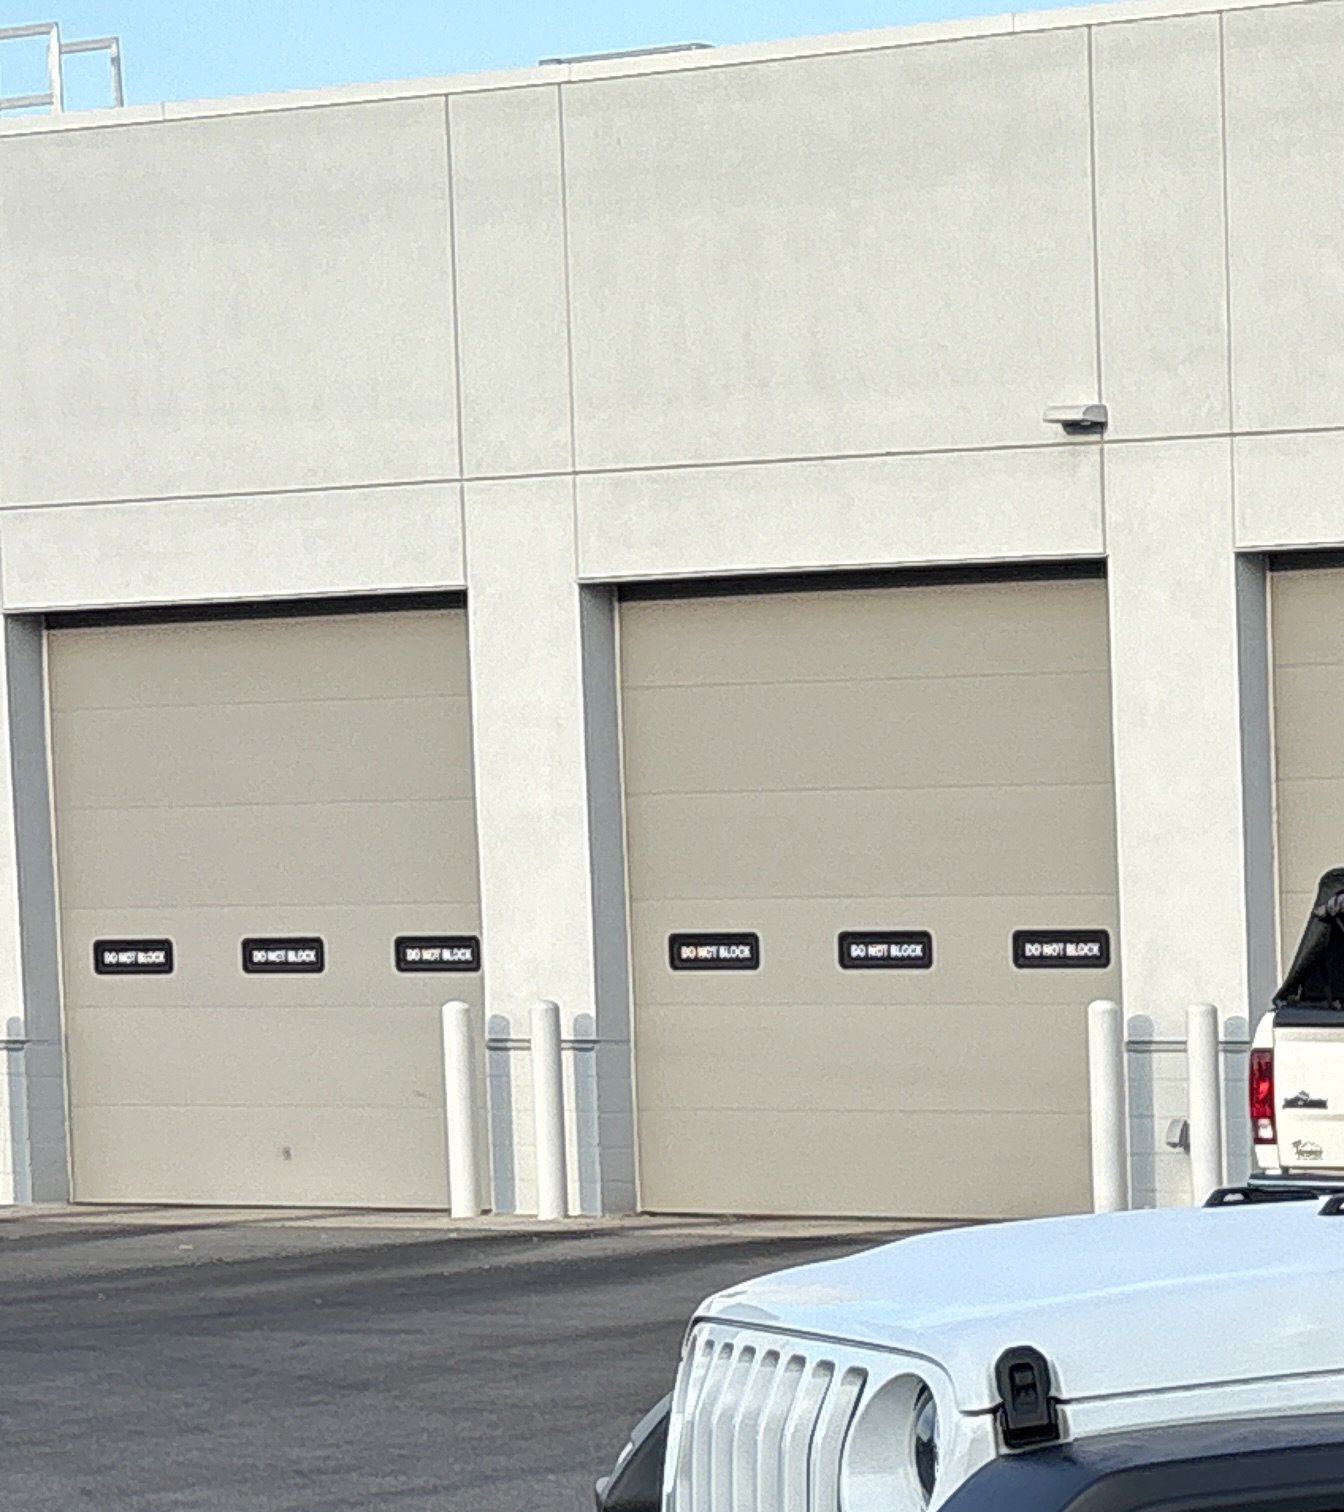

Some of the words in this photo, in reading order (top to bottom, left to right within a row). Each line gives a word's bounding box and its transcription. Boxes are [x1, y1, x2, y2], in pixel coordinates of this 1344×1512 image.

[252, 950, 266, 962] DO
[268, 950, 285, 962] NOT
[287, 949, 316, 962] BLOCK
[406, 948, 420, 961] DO
[422, 948, 440, 961] NOT
[442, 948, 472, 961] BLOCK
[681, 946, 696, 959] DO
[698, 946, 718, 959] NOT
[719, 945, 751, 959] BLOCK
[850, 944, 865, 957] DO
[868, 944, 887, 957] NOT
[890, 944, 923, 957] BLOCK
[1025, 943, 1041, 956] DO
[1043, 943, 1064, 956] NOT
[1066, 942, 1100, 956] BLOCK
[104, 951, 117, 964] DO
[119, 951, 136, 963] NOT
[138, 950, 165, 964] BLOCK
